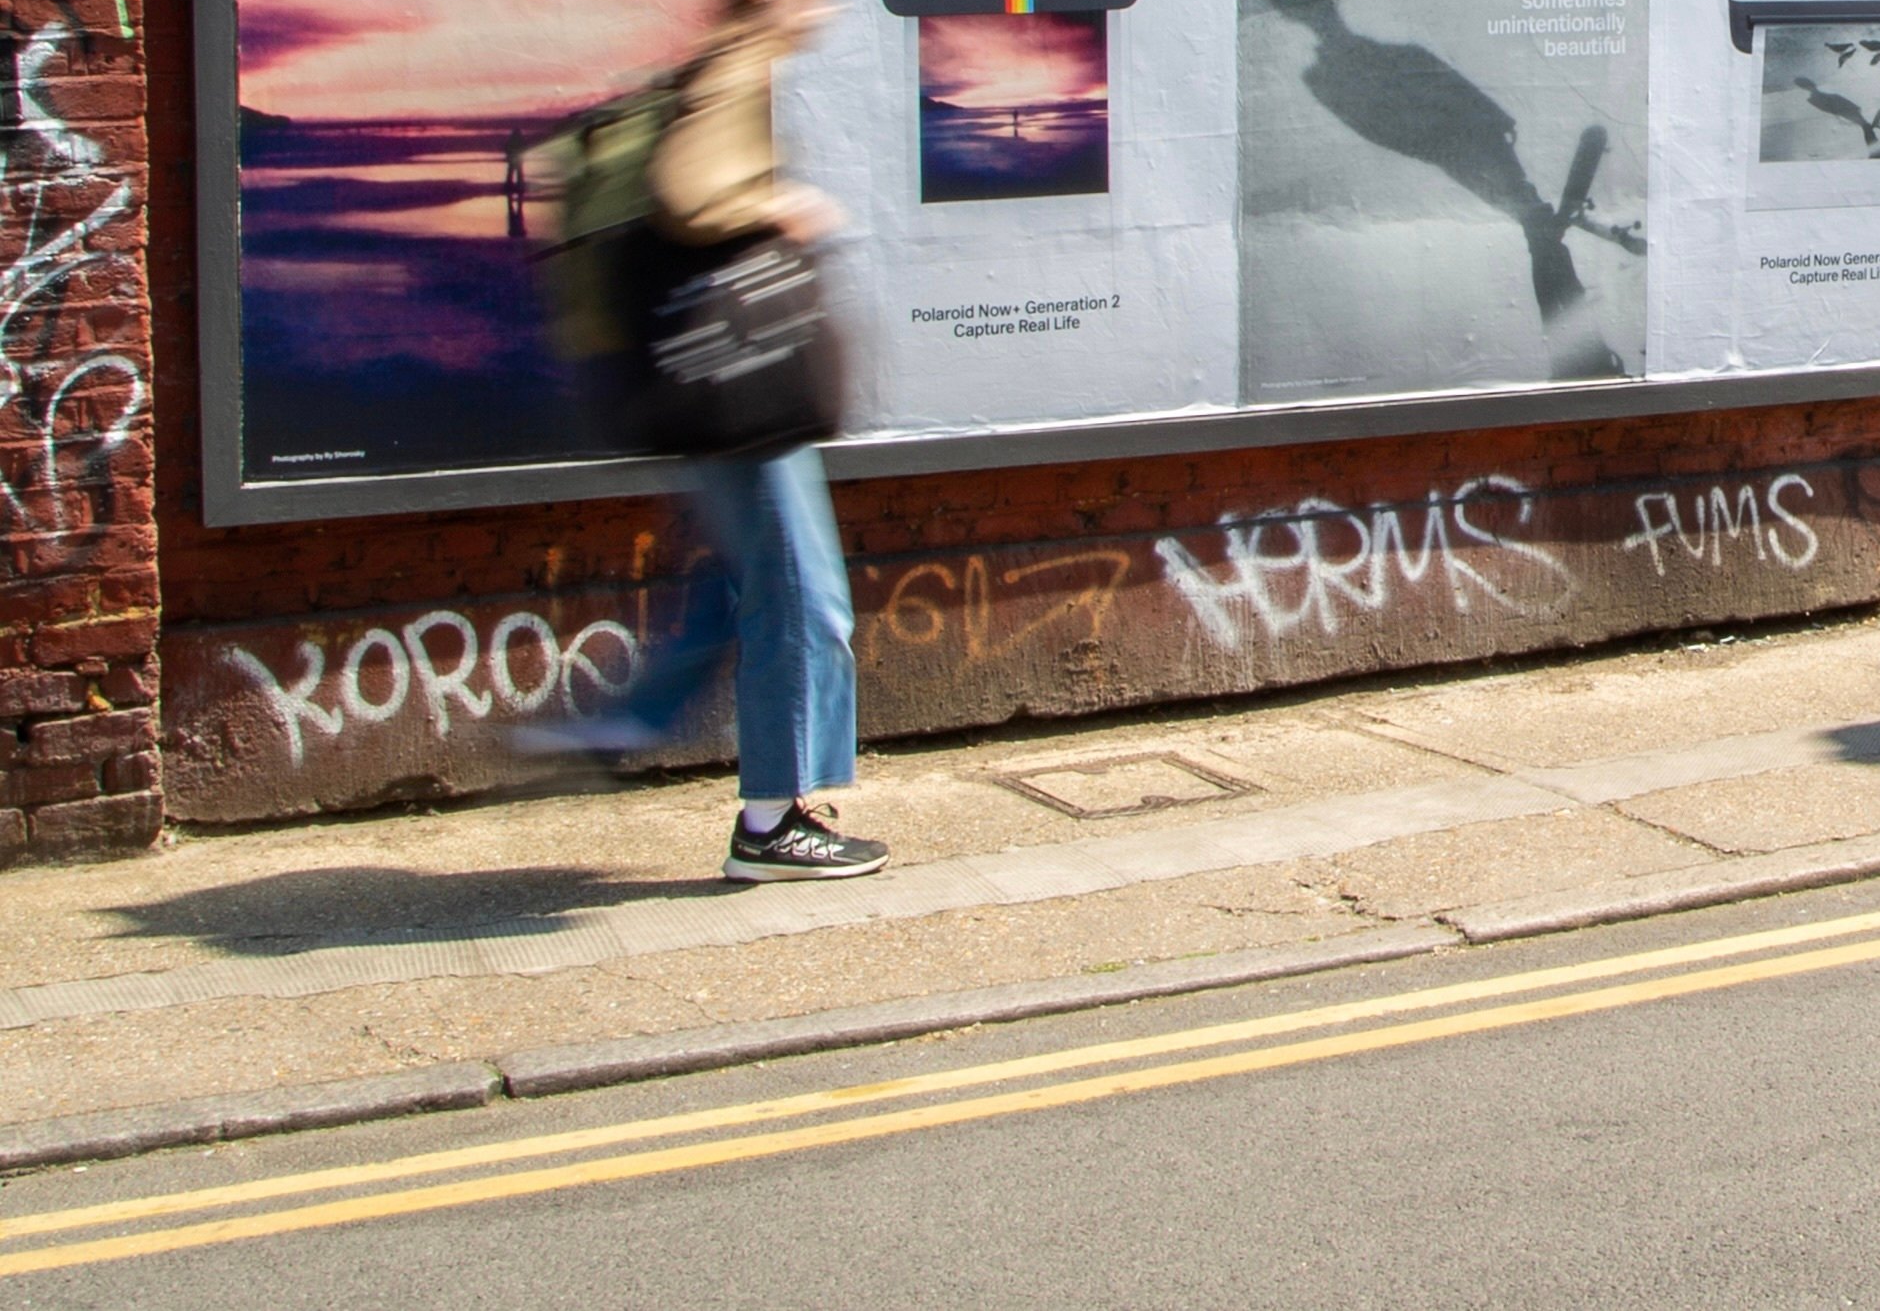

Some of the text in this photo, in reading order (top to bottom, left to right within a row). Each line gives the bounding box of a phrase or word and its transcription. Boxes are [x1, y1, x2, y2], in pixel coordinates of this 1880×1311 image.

[1487, 13, 1626, 36] unintentionally
[1544, 36, 1626, 56] beautiful
[1760, 255, 1811, 270] Polaroid
[1813, 254, 1840, 266] Now
[1789, 270, 1838, 285] Capture
[1841, 268, 1867, 281] Real
[911, 294, 1121, 323] Polaroid Now+ Generation 2
[953, 315, 1081, 339] Capture Real Life
